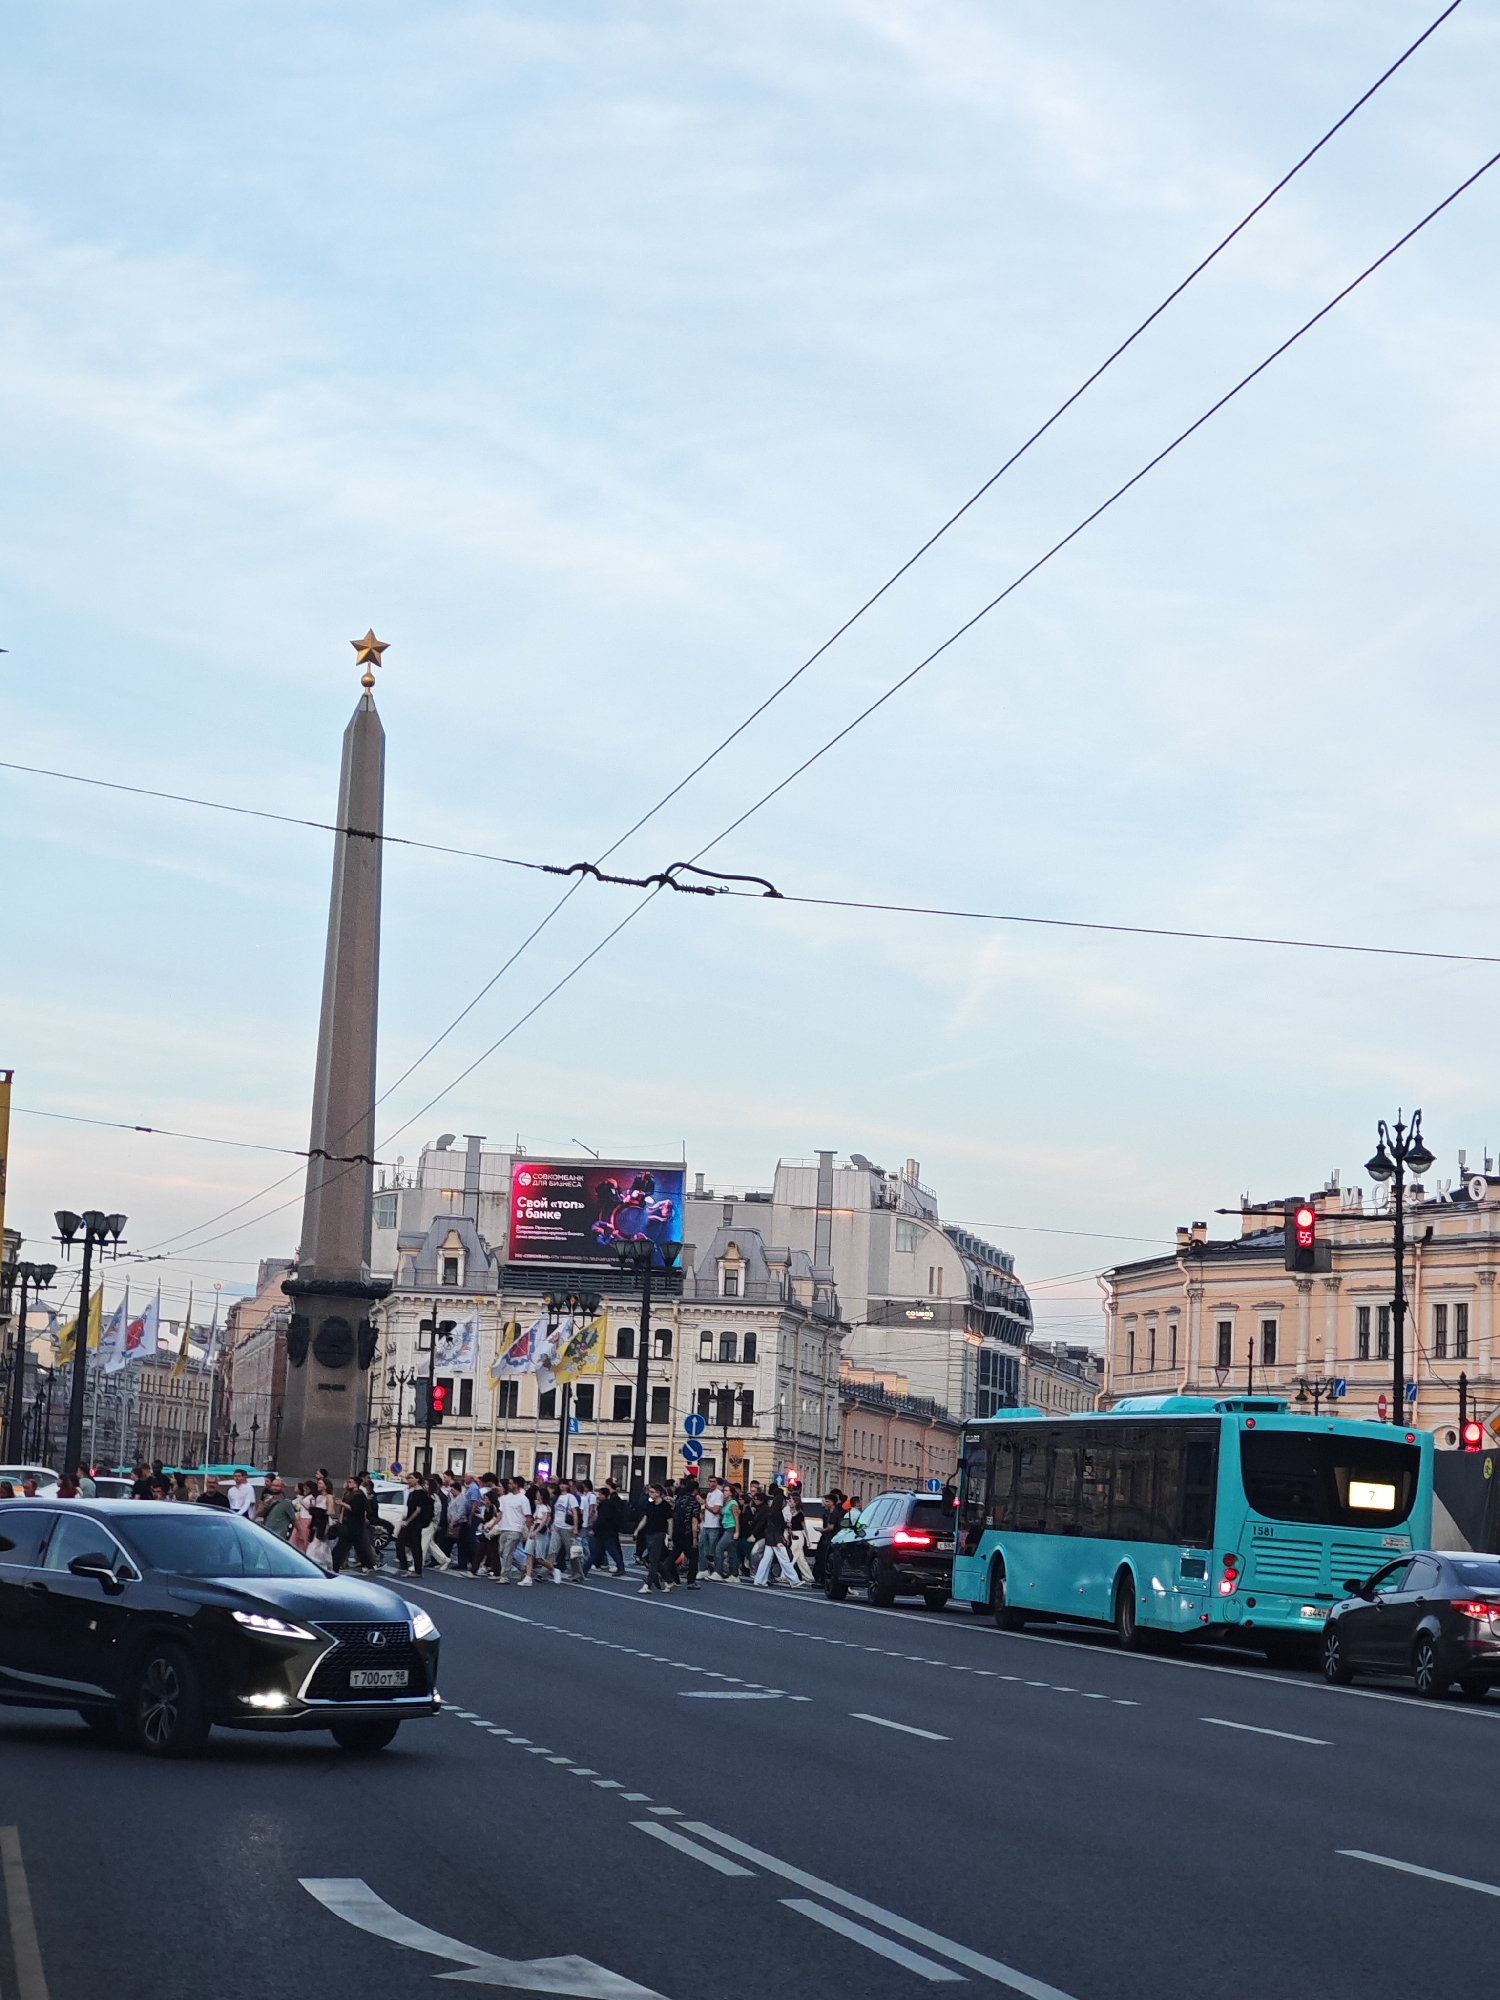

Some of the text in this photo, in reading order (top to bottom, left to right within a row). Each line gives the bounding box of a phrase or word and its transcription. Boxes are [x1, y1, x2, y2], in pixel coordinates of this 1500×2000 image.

[532, 1173, 584, 1181] СОВКОМБАНК
[517, 1196, 585, 1209] Свой «топ»
[516, 1208, 562, 1220] в банке
[1368, 1490, 1376, 1501] 7
[1252, 1525, 1274, 1537] 1581
